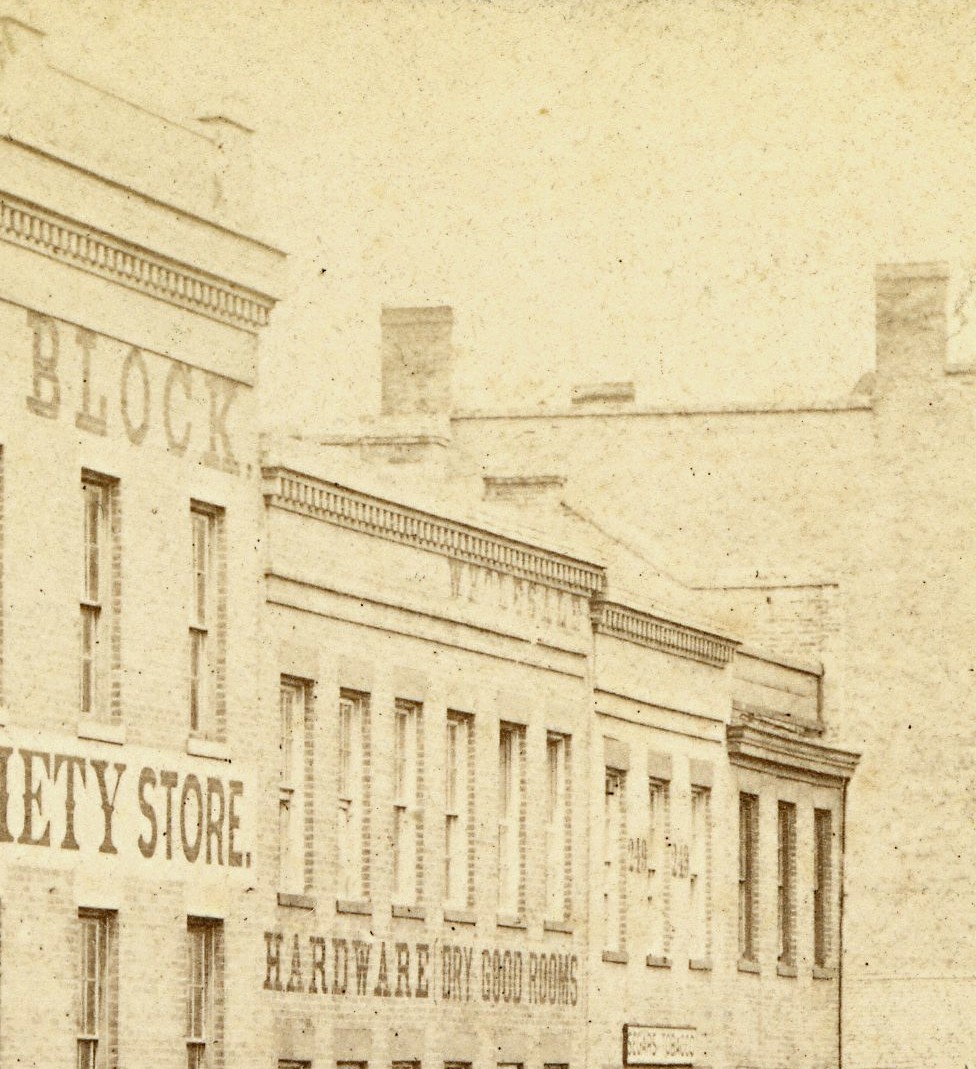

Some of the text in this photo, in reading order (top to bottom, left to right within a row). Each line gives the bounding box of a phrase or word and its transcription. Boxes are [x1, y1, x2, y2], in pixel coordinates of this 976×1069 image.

[137, 765, 252, 868] STORE.
[263, 931, 429, 998] HARDWARE
[442, 945, 473, 1000] DRY
[482, 949, 522, 1001] GOOD
